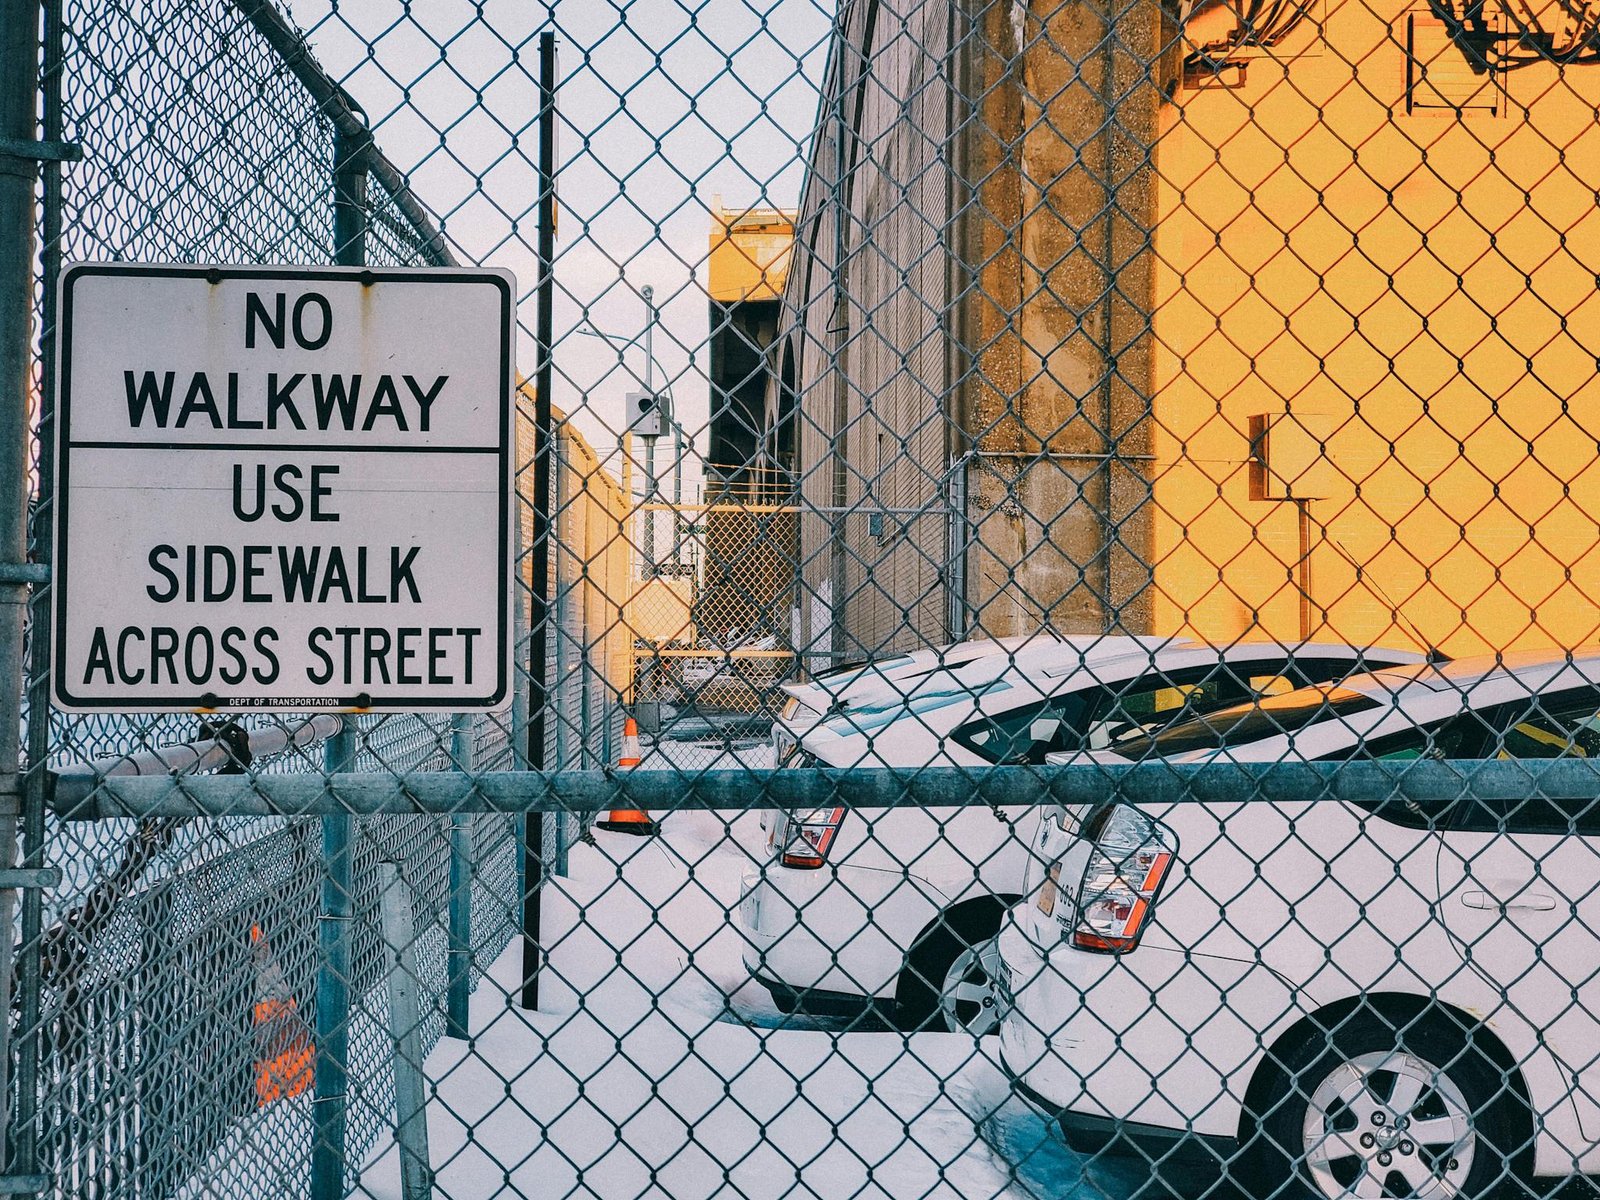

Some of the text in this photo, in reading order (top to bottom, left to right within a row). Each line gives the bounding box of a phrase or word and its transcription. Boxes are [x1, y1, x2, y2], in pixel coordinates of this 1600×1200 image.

[246, 293, 332, 350] NO
[124, 371, 449, 431] WALKWAY
[233, 464, 339, 522] USE
[147, 545, 421, 603] SIDEWALK
[83, 626, 481, 685] ACROSS STREET
[229, 698, 339, 706] DEPT OF TRANSPORTATION
